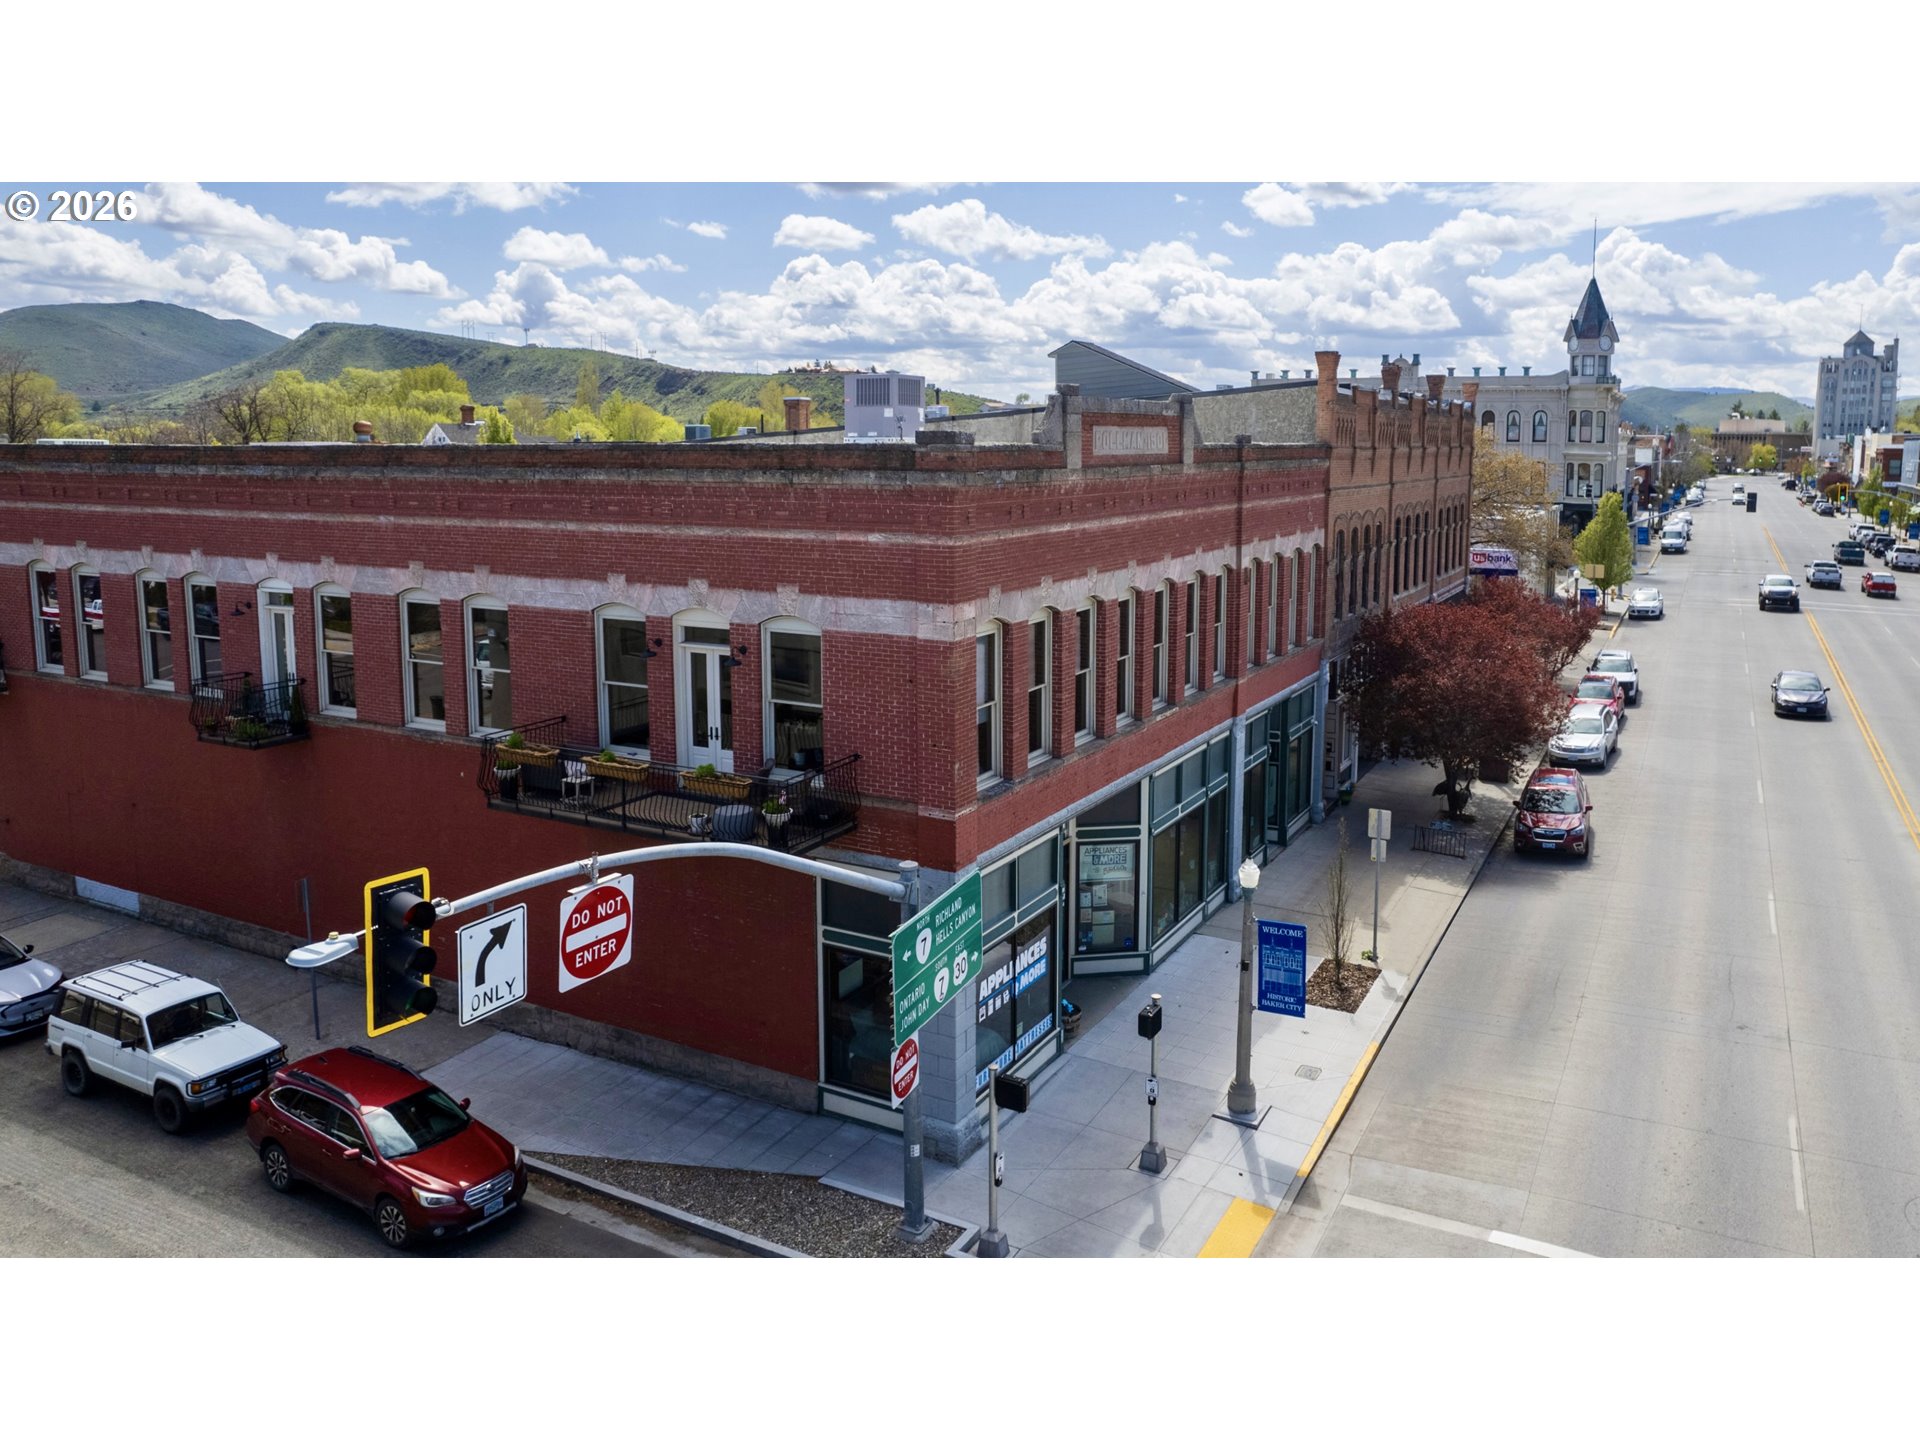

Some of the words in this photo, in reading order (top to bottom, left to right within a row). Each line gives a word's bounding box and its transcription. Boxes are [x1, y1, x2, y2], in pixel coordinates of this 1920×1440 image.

[1084, 846, 1127, 855] APPLIANCES
[572, 909, 590, 929] DO
[597, 896, 623, 918] NOT
[917, 914, 930, 930] NORTH
[935, 897, 962, 927] RICHLAND
[936, 922, 953, 946] HELLS
[955, 903, 976, 929] CANYON
[1262, 926, 1303, 938] WELCOME
[575, 938, 617, 968] ENTER
[921, 936, 927, 956] 7
[955, 940, 965, 953] EAST
[939, 976, 944, 996] 7
[955, 957, 966, 979] 30
[471, 977, 516, 1012] ONLY
[900, 982, 925, 1014] ONTARIO
[1261, 999, 1285, 1009] BAKER
[1285, 1004, 1302, 1012] CITY
[1267, 993, 1297, 1003] HISTORIC
[900, 1010, 916, 1032] JOHN
[918, 996, 930, 1017] DAY
[896, 1056, 904, 1070] DO
[905, 1043, 915, 1060] NOT
[898, 1070, 914, 1092] ENTER
